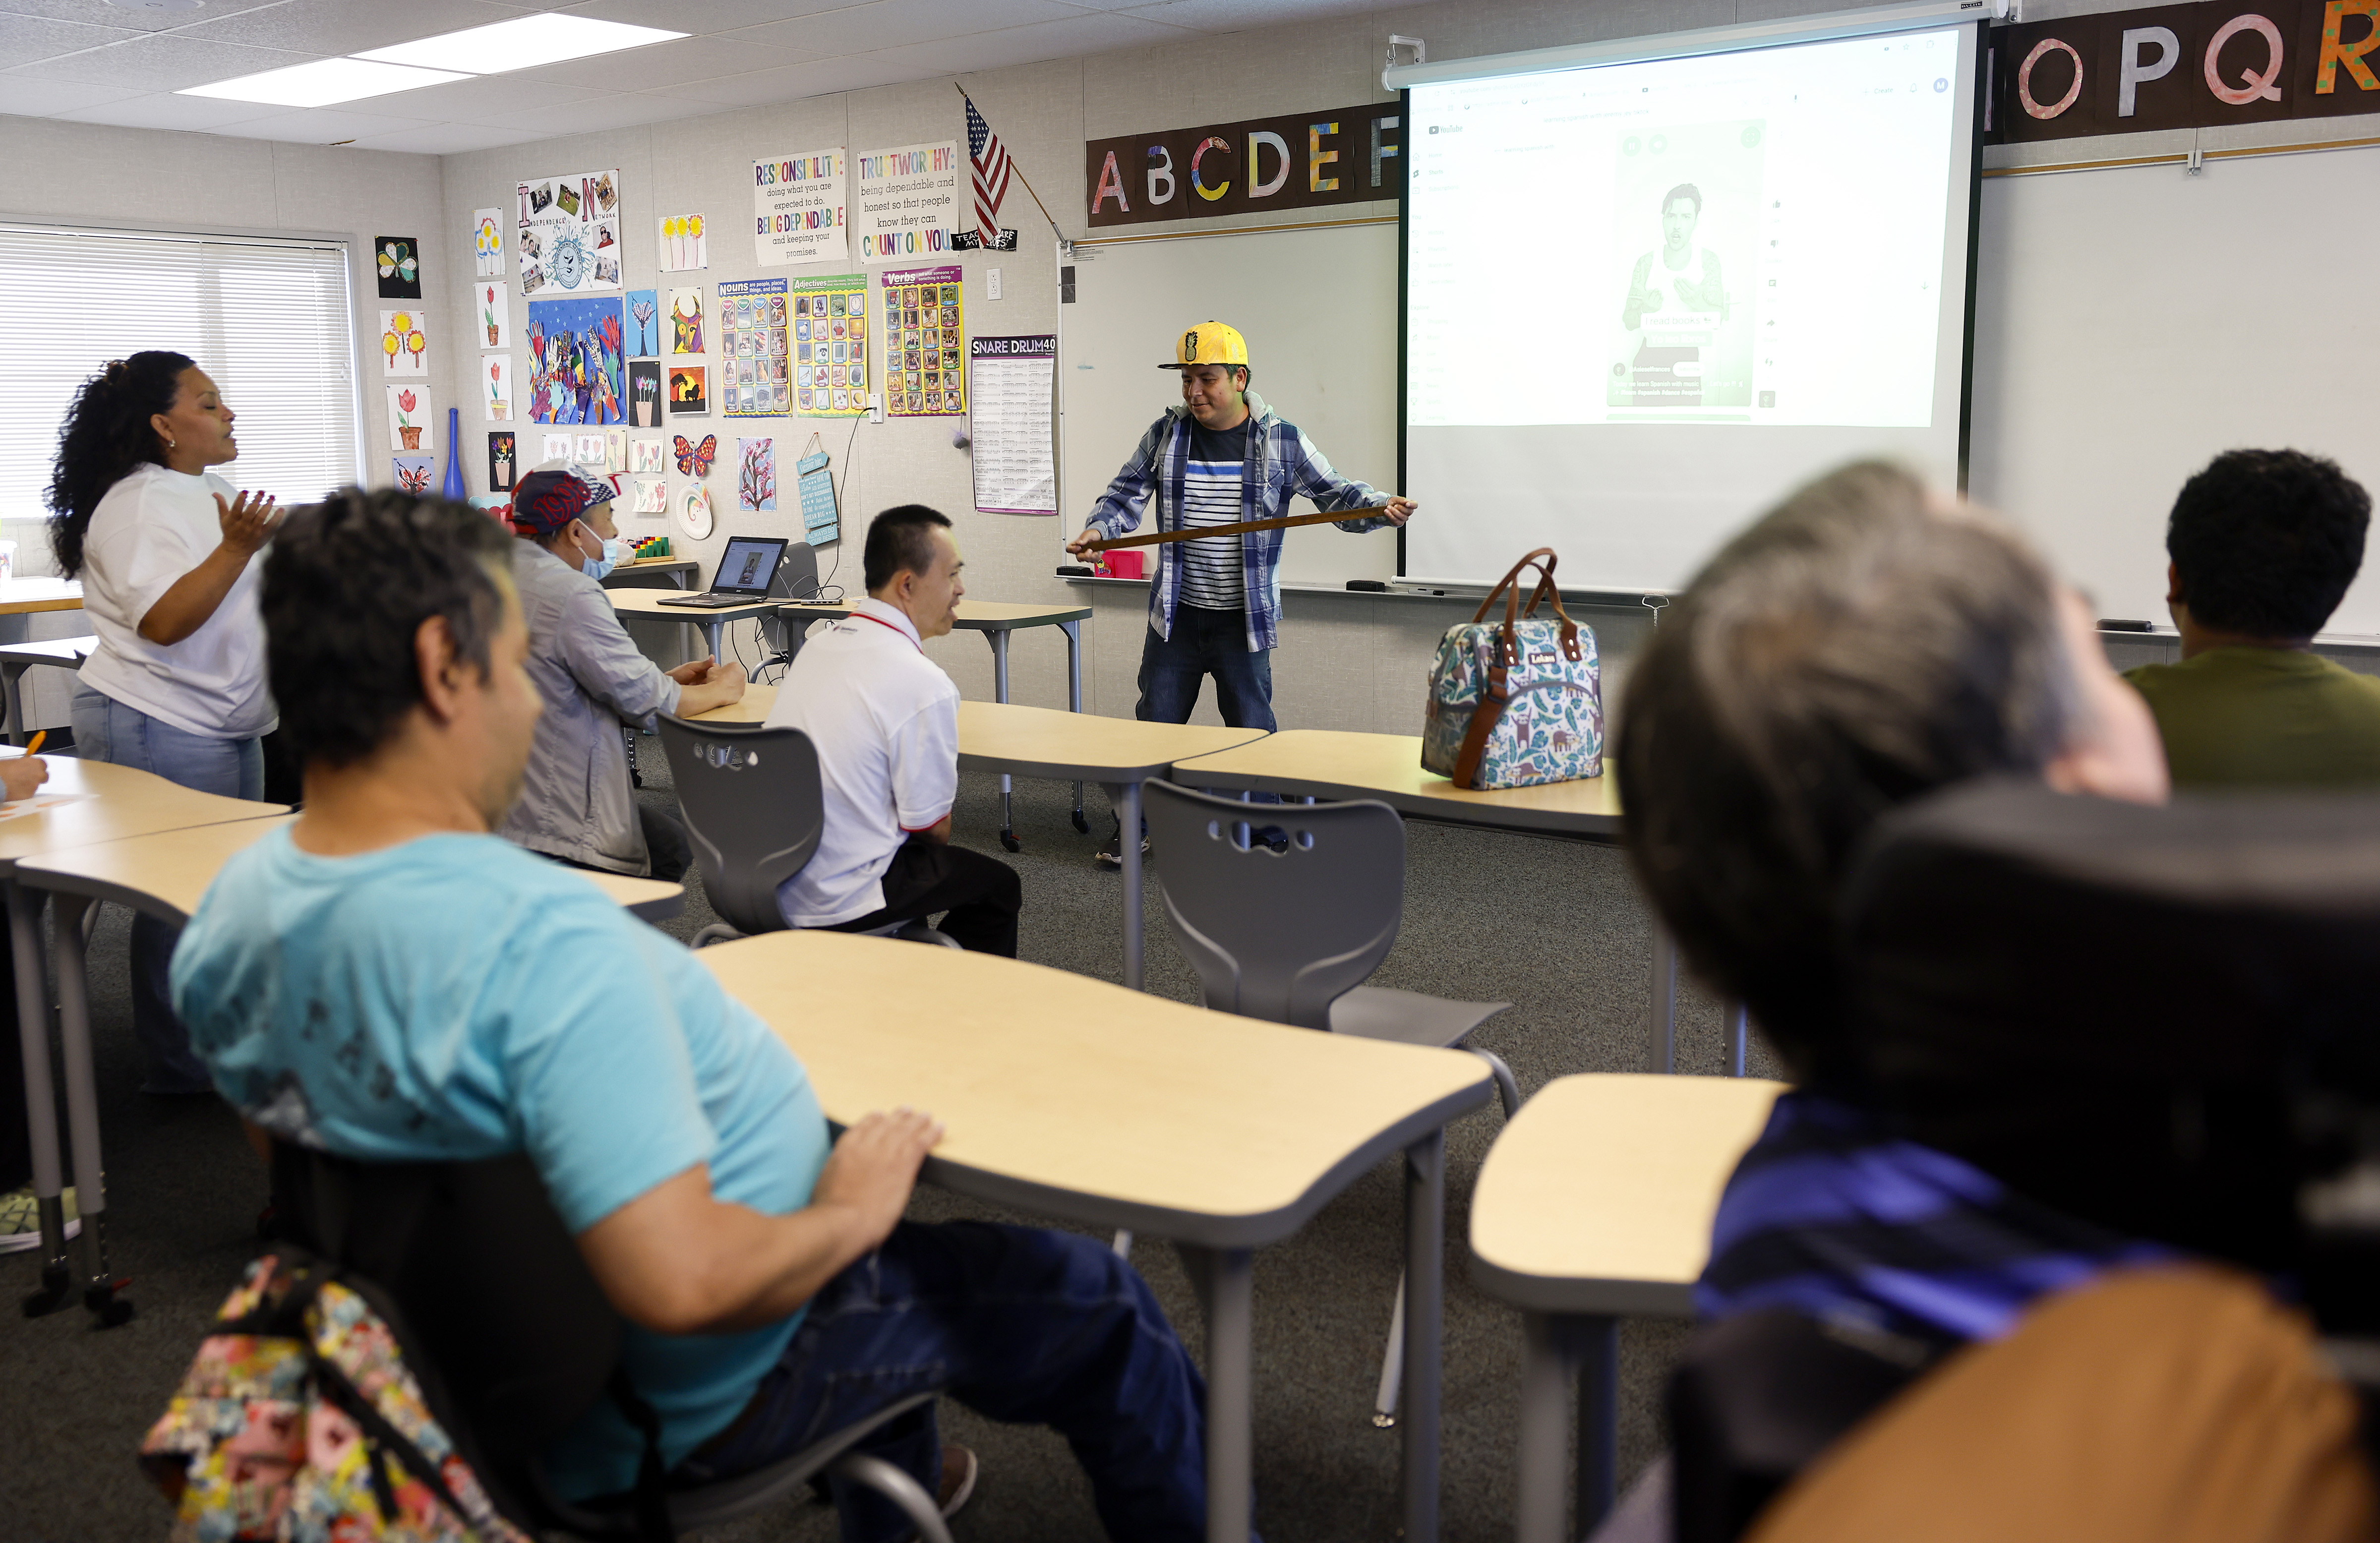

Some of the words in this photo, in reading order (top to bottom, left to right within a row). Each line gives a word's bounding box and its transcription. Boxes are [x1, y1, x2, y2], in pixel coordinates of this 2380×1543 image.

[2018, 38, 2082, 120] O
[2119, 26, 2180, 118] P
[2204, 14, 2283, 105] Q
[2315, 0, 2380, 94] R
[1936, 81, 1945, 90] M
[1440, 125, 1463, 134] YouTube
[860, 147, 954, 179] TRUSTWORTHY:
[1091, 151, 1130, 214] A
[1147, 146, 1175, 205] B
[1191, 136, 1231, 201] C
[1249, 131, 1290, 198] D
[1309, 122, 1339, 192] E
[1370, 116, 1399, 187] F
[756, 154, 843, 186] RESPONSIBILITY:
[767, 188, 785, 196] doing
[787, 185, 803, 194] what
[805, 184, 818, 193] you
[861, 185, 883, 196] being
[886, 178, 934, 193] dependable
[937, 176, 954, 187] and
[774, 198, 803, 210] expected
[814, 197, 825, 205] do.
[864, 201, 890, 212] honest
[903, 198, 919, 208] that
[921, 194, 950, 208] people
[758, 215, 782, 235] BEING
[784, 207, 843, 232] DEPENDABLE
[877, 218, 898, 227] know
[901, 215, 919, 226] they
[773, 236, 785, 244] and
[787, 234, 813, 243] keeping
[816, 233, 830, 241] your
[1000, 230, 1015, 240] ARE
[863, 233, 902, 257] COUNT
[906, 231, 922, 253] ON
[786, 248, 818, 258] promises.
[794, 279, 827, 289] Adjectives
[888, 272, 916, 284] Verbs
[719, 283, 748, 296] Nouns
[1672, 316, 1700, 325] books
[1651, 334, 1663, 343] Yo
[1665, 334, 1679, 343] leo
[1681, 334, 1706, 343] libros
[972, 340, 1008, 354] SNARE
[1011, 339, 1043, 353] DRUM
[1043, 339, 1056, 349] 40
[814, 487, 832, 496] DISCOURAGED
[804, 513, 817, 522] DREAM
[808, 530, 827, 539] ALWAYS
